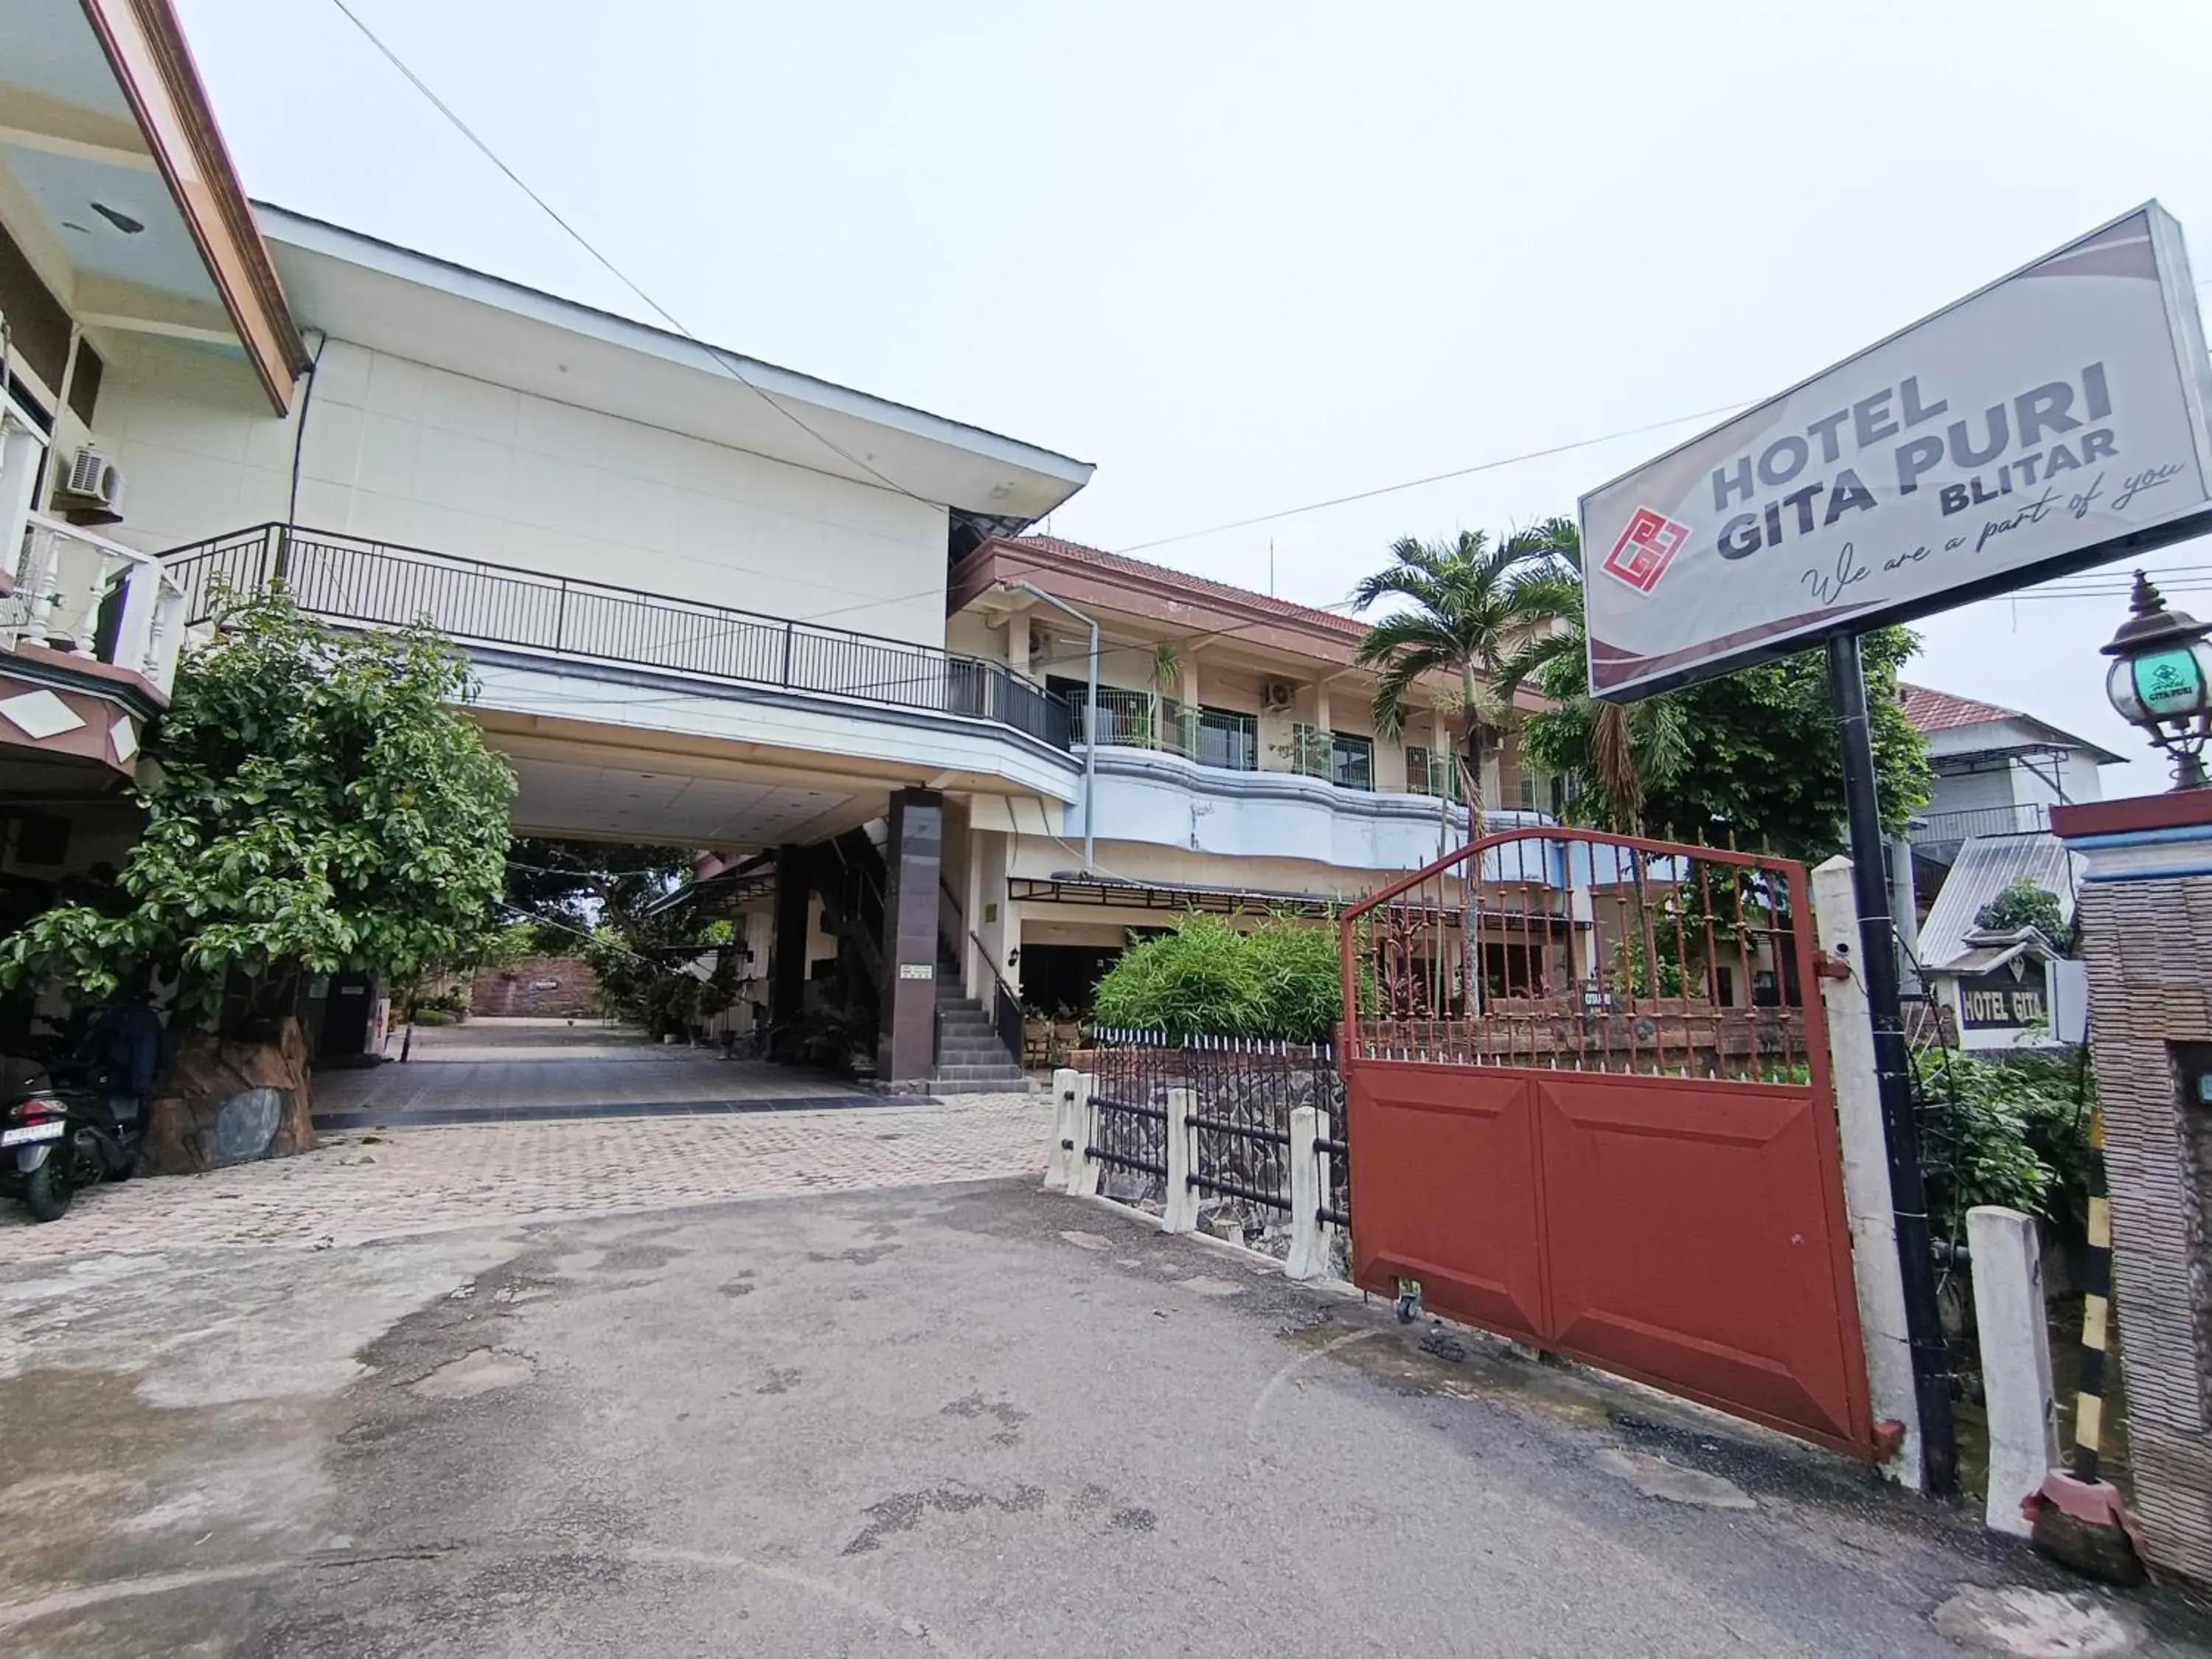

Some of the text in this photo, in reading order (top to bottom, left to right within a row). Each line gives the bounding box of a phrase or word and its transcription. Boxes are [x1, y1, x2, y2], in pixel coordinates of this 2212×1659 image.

[1712, 375, 1948, 512] HOTEL
[1717, 361, 2112, 560] GITA PURI
[1939, 428, 2119, 517] BLITAR
[1801, 462, 2185, 605] We are a part of you
[1962, 991, 2042, 1022] HOTEL GITA
